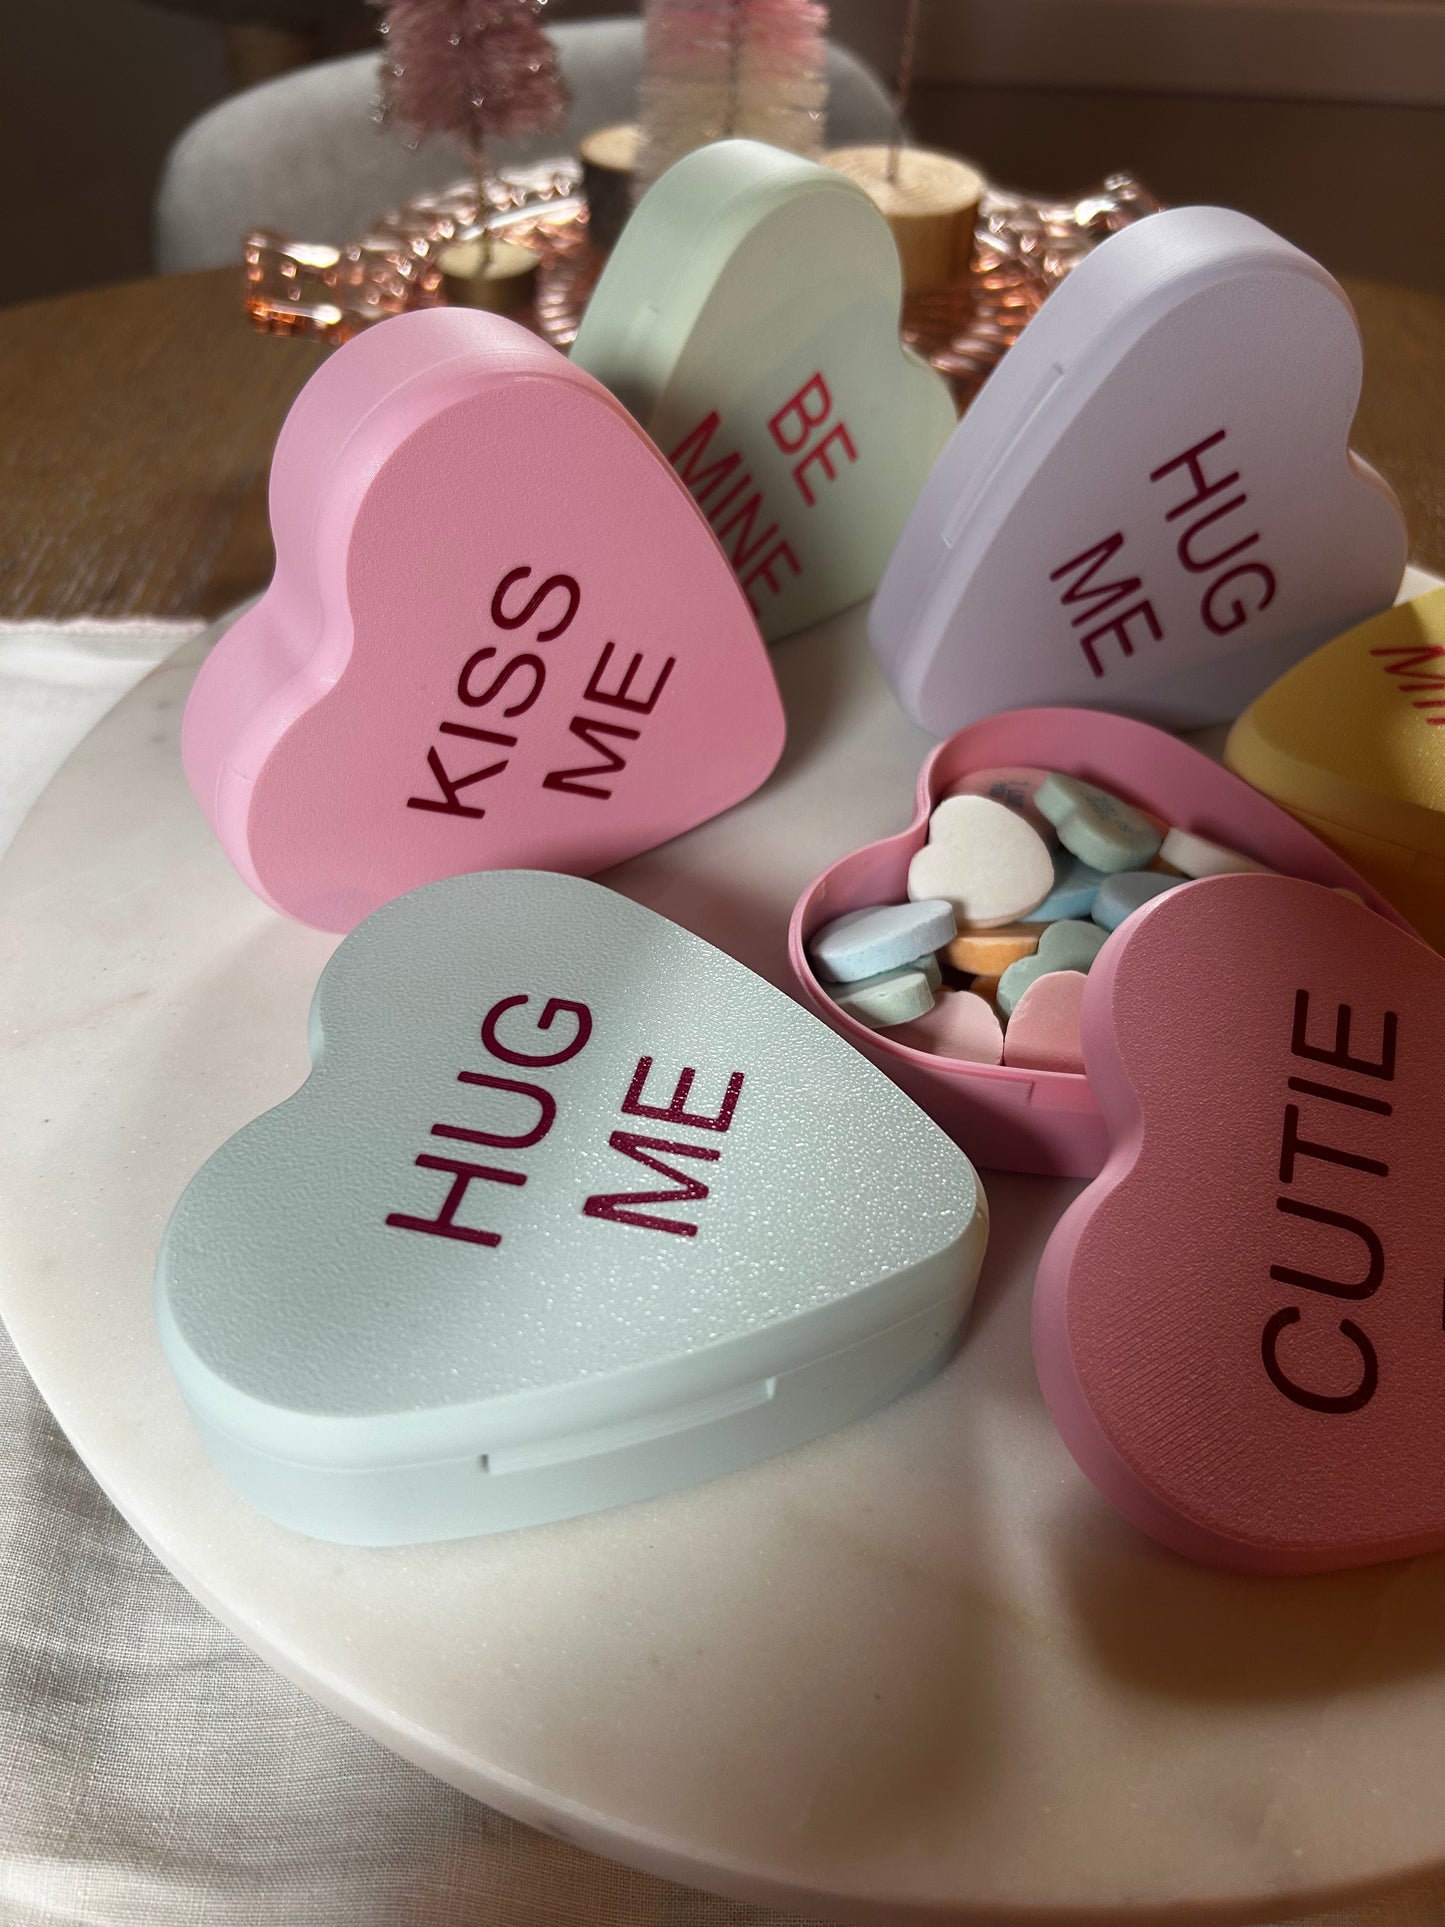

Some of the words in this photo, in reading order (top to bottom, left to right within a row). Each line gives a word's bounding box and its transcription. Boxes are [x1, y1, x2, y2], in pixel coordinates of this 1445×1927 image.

[669, 410, 802, 619] MINE
[766, 371, 859, 508] BE
[1150, 429, 1277, 637] HUG
[406, 566, 581, 819] KISS
[1049, 531, 1165, 680] ME
[542, 641, 676, 800] ME
[386, 994, 593, 1247] HUG
[581, 1056, 745, 1237] ME
[1261, 988, 1398, 1414] CUTIE
